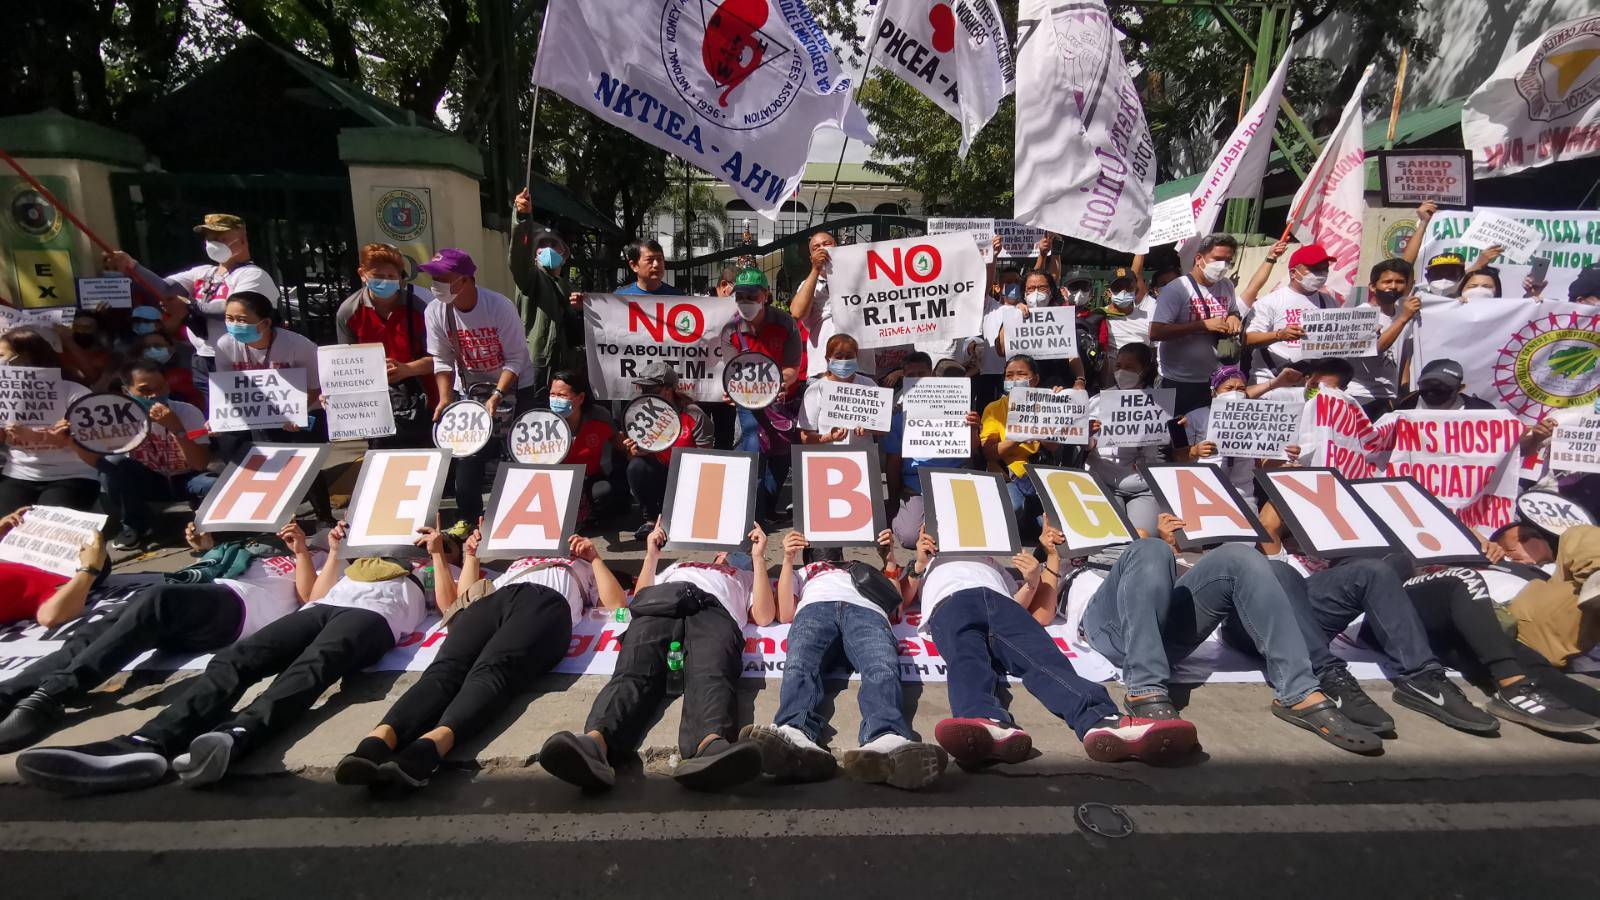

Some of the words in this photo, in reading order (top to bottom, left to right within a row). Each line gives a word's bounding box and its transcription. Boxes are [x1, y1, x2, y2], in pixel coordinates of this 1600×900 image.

[666, 6, 682, 43] KIDNEY
[955, 0, 989, 46] WORKERS
[672, 48, 691, 91] NATIONAL
[744, 80, 793, 125] ASSOCIATION
[696, 99, 720, 120] 1996
[593, 71, 705, 154] NKTIEA
[721, 150, 788, 204] AHW
[1396, 160, 1452, 168] SAHOD
[1402, 168, 1447, 176] itaas!
[1395, 176, 1456, 184] PRESYO
[1496, 215, 1527, 234] HEALTH
[867, 244, 942, 286] NO
[842, 294, 861, 306] TO
[866, 284, 949, 304] ABOLITION
[953, 281, 974, 293] OF
[863, 298, 955, 326] R.I.T.M.
[1023, 311, 1055, 324] HEA
[1322, 311, 1351, 321] Emergency
[1352, 311, 1376, 319] Allowance
[629, 302, 705, 343] NO
[1015, 325, 1065, 337] IBIGAY
[1010, 338, 1042, 350] NOW
[1048, 337, 1071, 348] NA!
[598, 344, 619, 355] TO
[624, 345, 709, 357] ABOLITION
[331, 357, 364, 365] RELEASE
[0, 370, 36, 380] LTH
[333, 368, 365, 376] HEALTH
[730, 361, 774, 383] 33K
[234, 374, 280, 389] HEA
[326, 379, 375, 388] EMERGENCY
[225, 389, 291, 403] IBIGAY
[836, 386, 879, 398] RELEASE
[331, 400, 379, 409] ALLOWANCE
[829, 394, 885, 407] IMMEDIATELY
[1121, 394, 1155, 407] HEA
[215, 405, 261, 420] NOW
[267, 403, 300, 416] NA!
[834, 404, 851, 412] ALL
[852, 405, 878, 415] COVID
[1010, 402, 1035, 412] Based
[1063, 405, 1085, 414] (PBB)
[1225, 402, 1284, 413] HEALTH
[75, 403, 138, 428] 33K
[337, 412, 358, 420] NOW
[443, 411, 487, 431] 33K
[626, 398, 665, 439] 33K
[827, 411, 870, 422] BENEFITS!
[1019, 415, 1039, 424] 2020
[1055, 417, 1073, 425] 2021
[1111, 409, 1162, 422] IBIGAY
[1213, 411, 1298, 422] EMERGENCY
[516, 419, 561, 443] 33K
[641, 408, 675, 449] SALARY!
[1008, 425, 1057, 435] IBIGAY
[1103, 424, 1139, 436] NOW
[1212, 421, 1296, 432] ALLOWANCE
[439, 430, 488, 443] SALARY!
[1217, 431, 1263, 440] IBIGAY
[1267, 433, 1290, 442] NA!
[516, 439, 567, 456] SALARY!
[1221, 441, 1252, 450] NOW
[1257, 442, 1279, 451] NA!
[1569, 442, 1597, 452] 2020
[209, 455, 305, 520] H
[366, 455, 429, 536] E
[490, 472, 561, 540] A
[691, 463, 726, 540] I
[807, 457, 873, 532] B
[950, 479, 987, 548] I
[1048, 472, 1132, 538] G
[1175, 470, 1251, 533] A
[1271, 474, 1359, 540] Y
[1522, 499, 1580, 520] 33K
[1426, 567, 1489, 600] JORDAN
